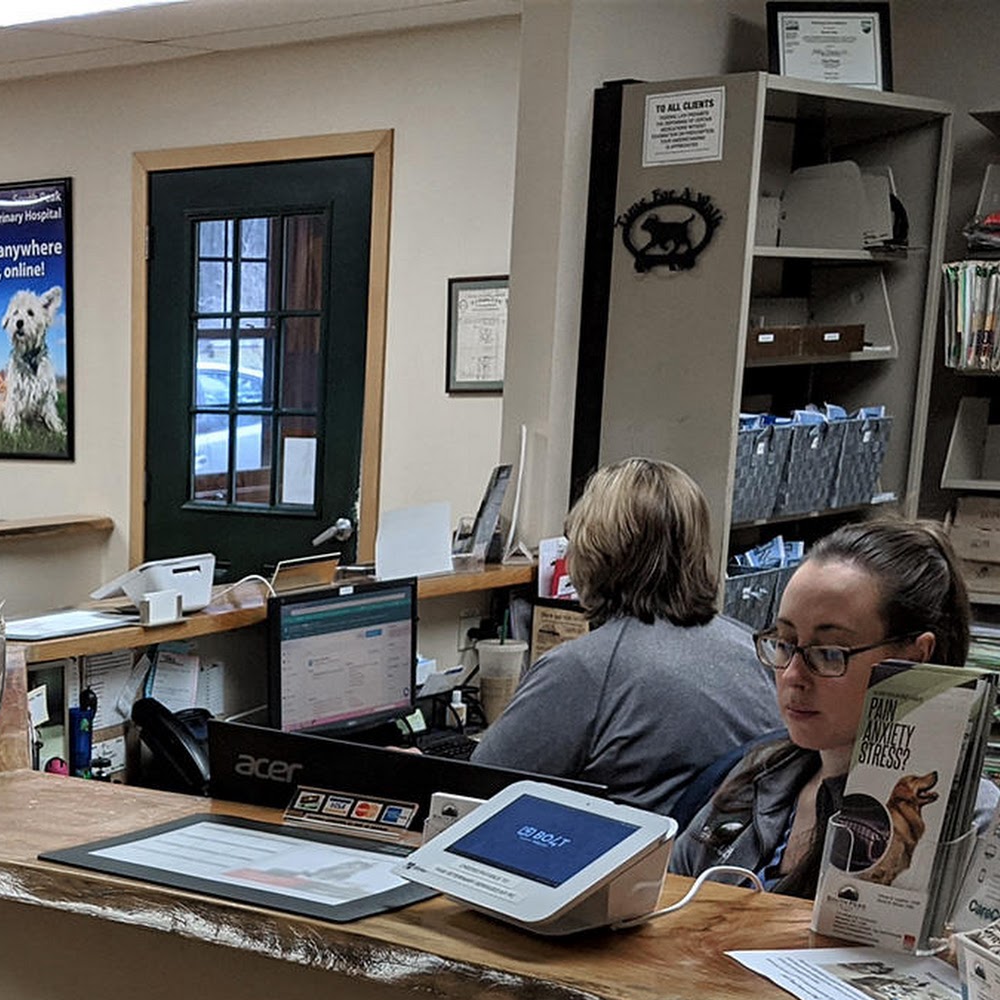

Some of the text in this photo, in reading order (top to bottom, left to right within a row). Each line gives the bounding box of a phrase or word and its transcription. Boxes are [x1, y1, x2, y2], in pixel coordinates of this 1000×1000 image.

[656, 98, 715, 113] TO ALL CLIENTS
[24, 206, 62, 222] Hospital
[4, 261, 46, 278] online!
[868, 697, 898, 722] PAIN
[862, 719, 916, 748] ANXIETY
[234, 754, 303, 783] acer
[858, 741, 911, 771] STRESS?
